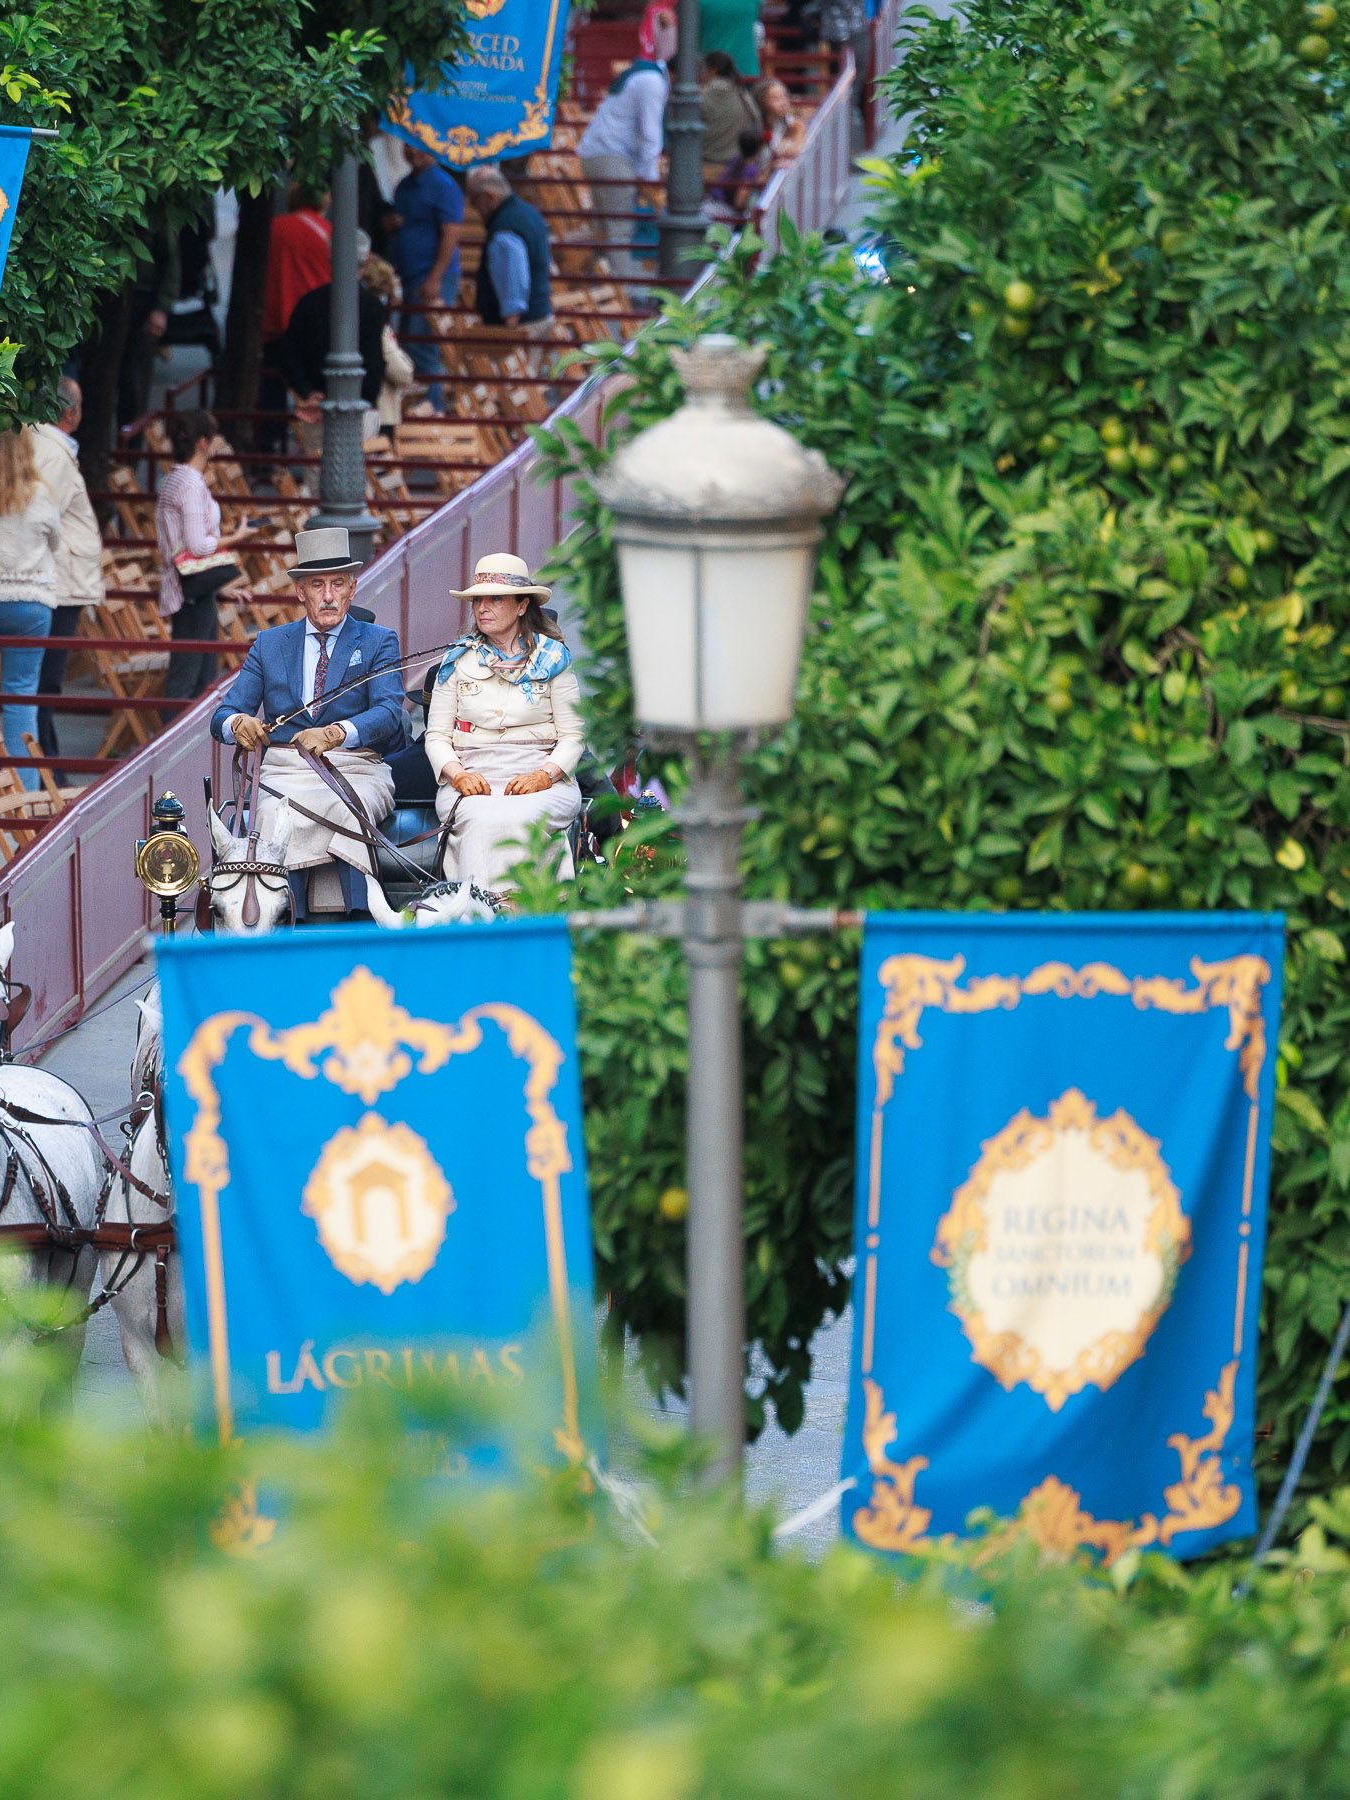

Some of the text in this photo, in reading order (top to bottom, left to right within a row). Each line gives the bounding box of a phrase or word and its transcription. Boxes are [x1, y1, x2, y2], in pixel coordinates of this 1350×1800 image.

[1002, 1203, 1131, 1235] REGINA
[990, 1271, 1132, 1299] OMNIUM
[264, 1339, 526, 1395] LÁGRIMAS
